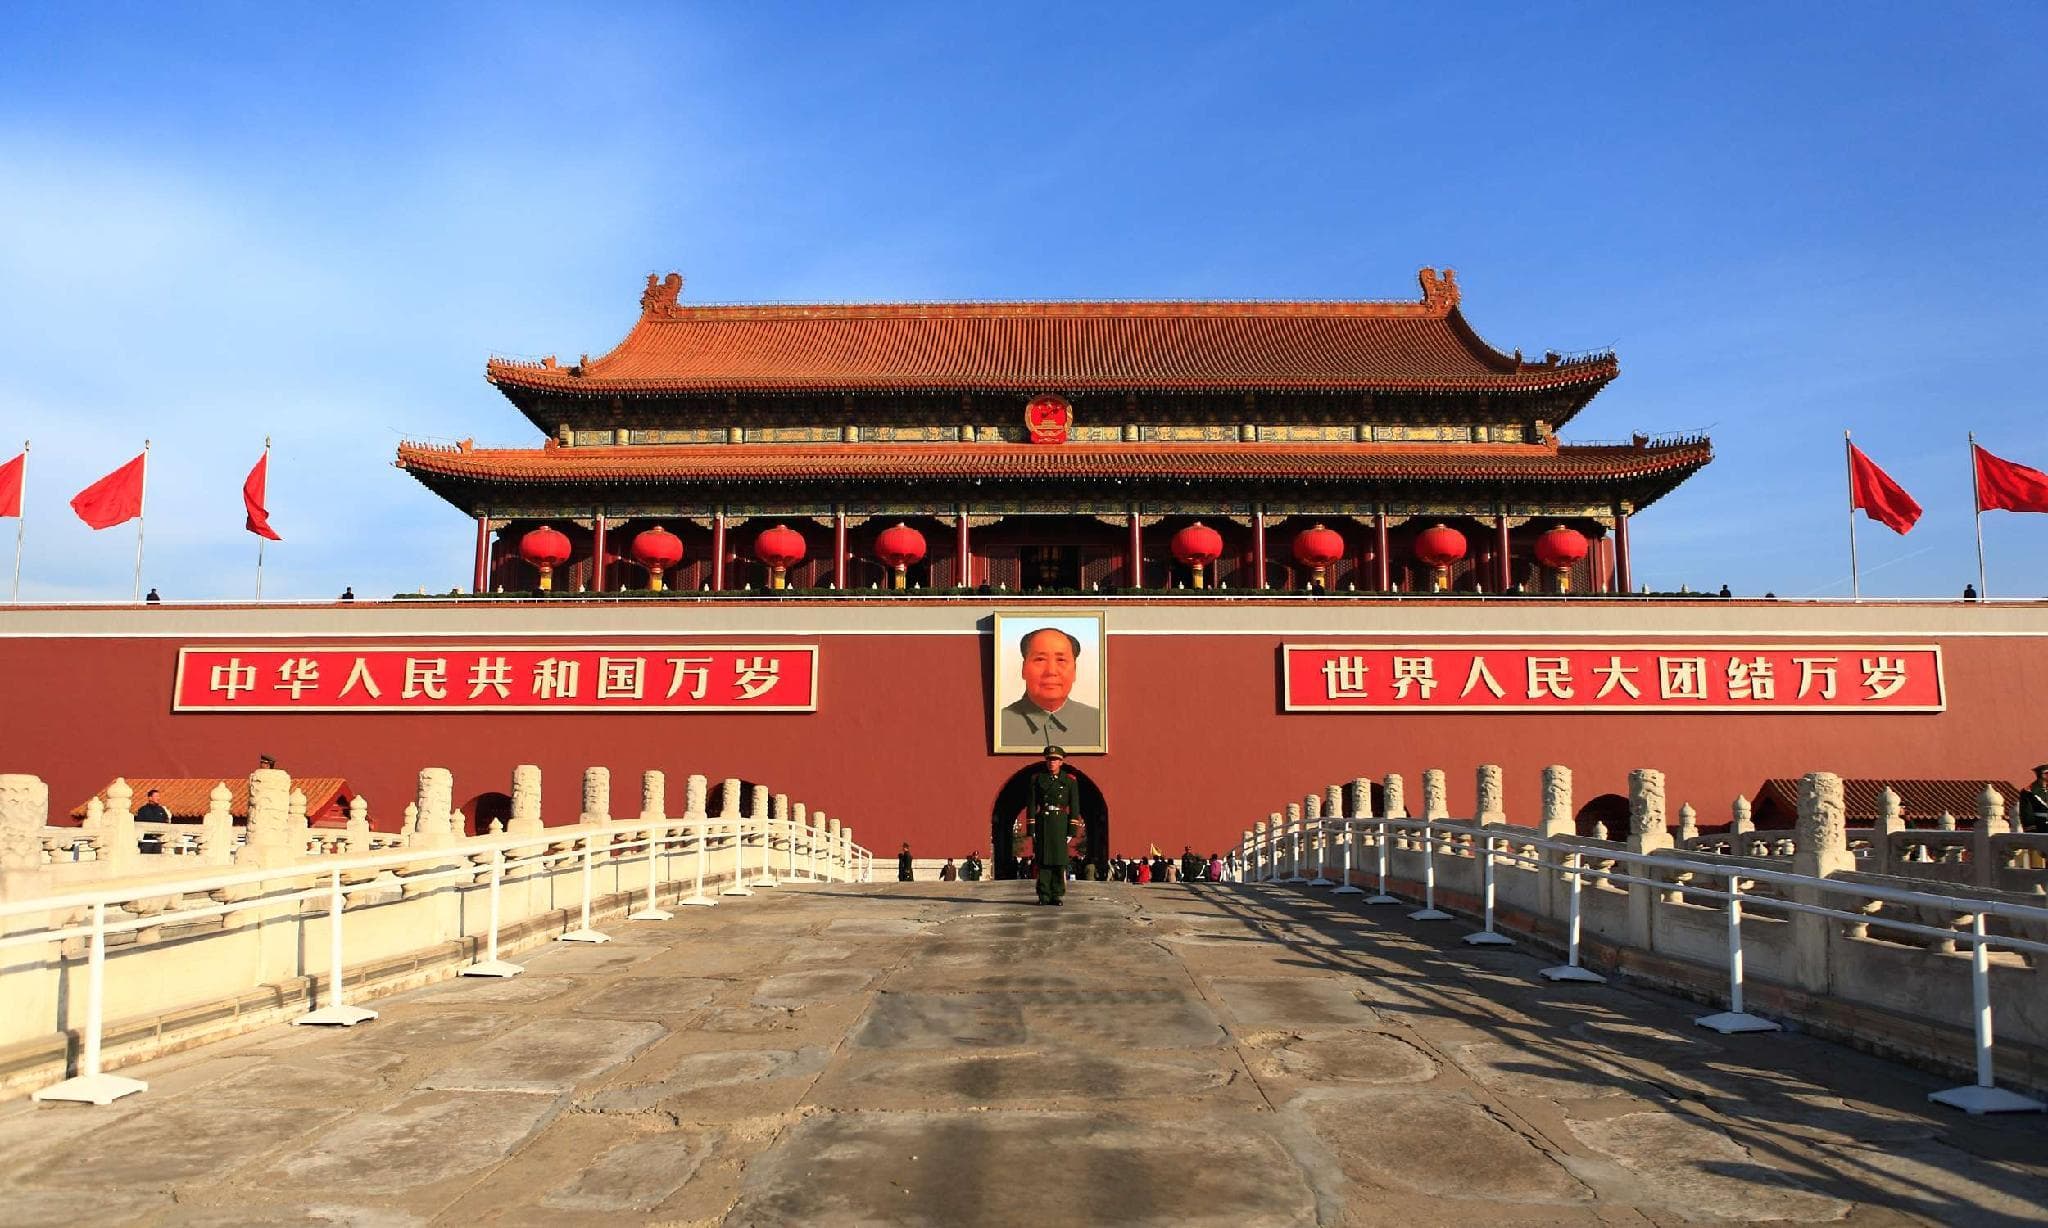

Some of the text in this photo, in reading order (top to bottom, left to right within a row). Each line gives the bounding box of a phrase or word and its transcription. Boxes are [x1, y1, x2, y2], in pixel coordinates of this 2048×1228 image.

[209, 656, 780, 699] 中华人民共和国万岁
[1321, 656, 1908, 699] 世界人民大团结万岁
